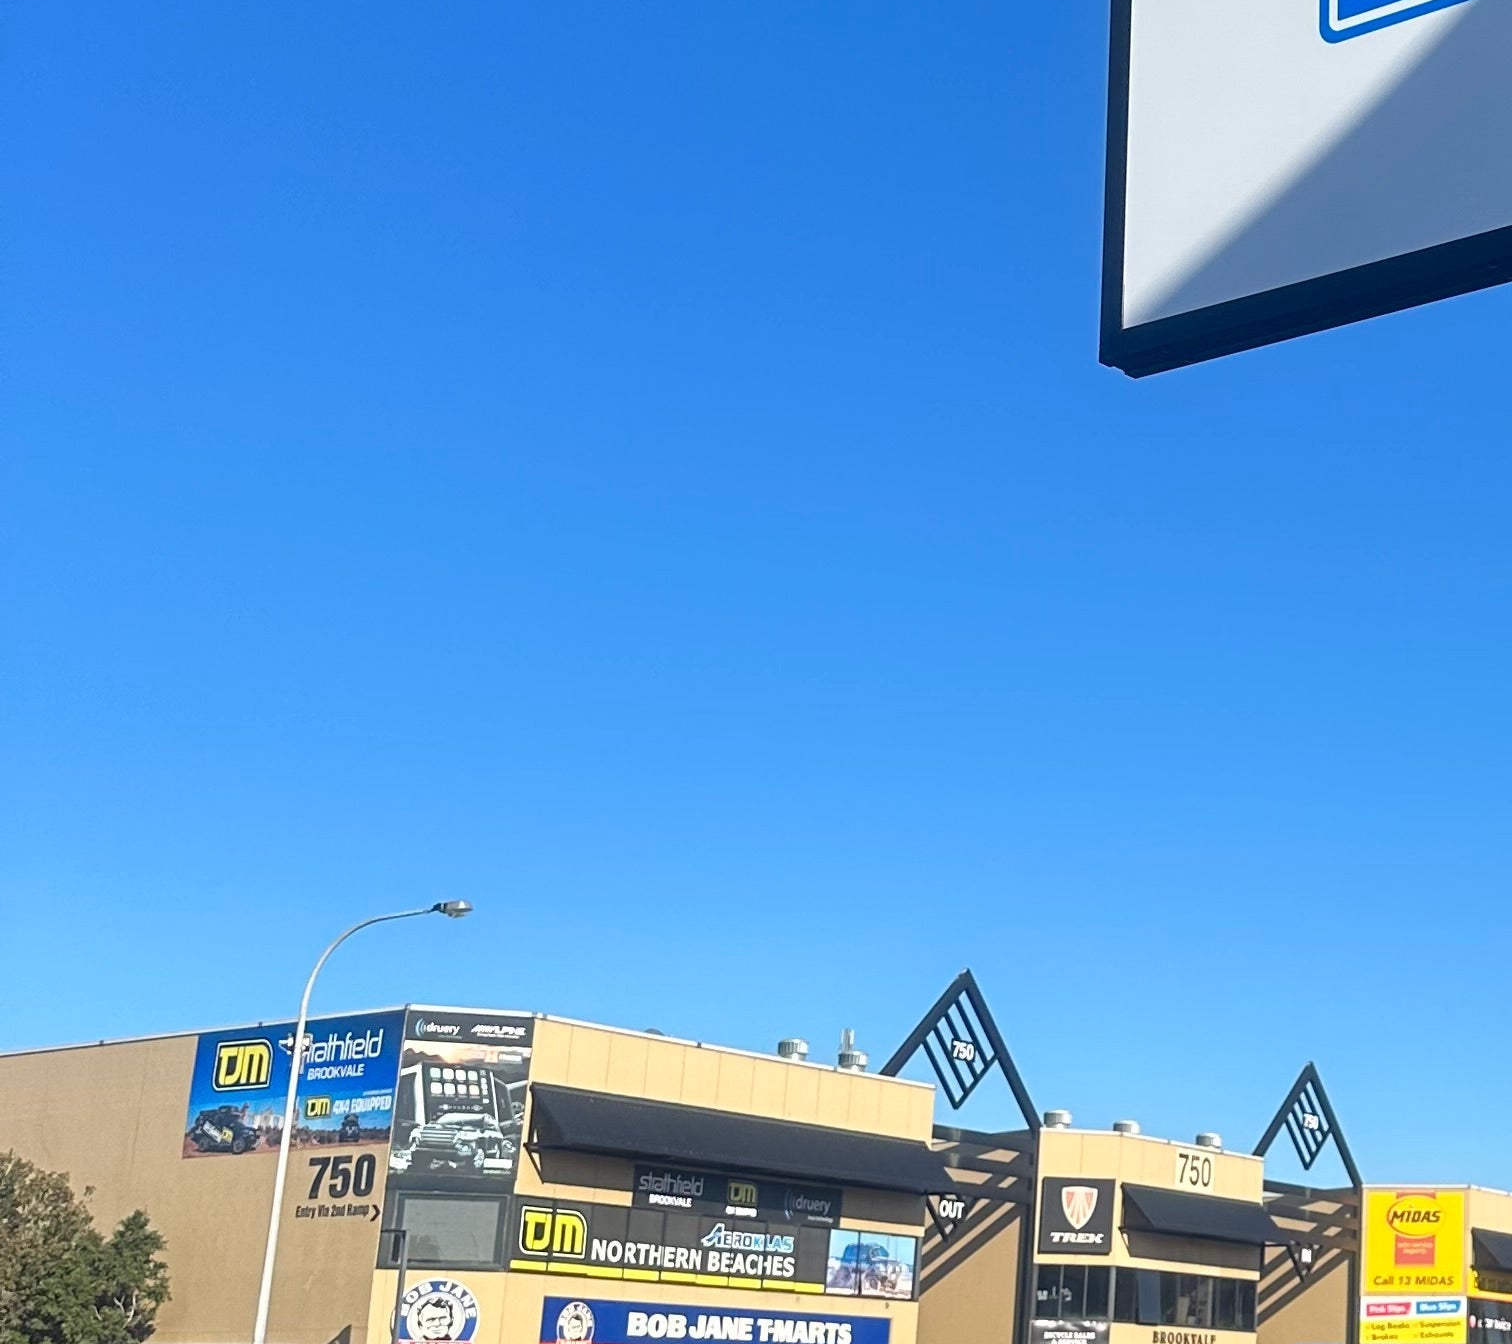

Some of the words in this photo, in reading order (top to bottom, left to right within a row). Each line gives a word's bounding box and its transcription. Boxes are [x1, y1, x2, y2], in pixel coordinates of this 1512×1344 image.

[952, 1040, 975, 1061] 750
[307, 1064, 365, 1081] BROOKVALE
[1303, 1113, 1319, 1130] 750
[308, 1153, 376, 1200] 750
[1178, 1153, 1212, 1188] 750
[638, 1172, 704, 1198] strathfield
[296, 1205, 316, 1219] Entry
[940, 1199, 965, 1219] OUT
[1390, 1210, 1441, 1225] MIDAS
[1050, 1231, 1104, 1244] TREK
[591, 1238, 701, 1270] NORTHERN
[707, 1250, 795, 1278] BEACHES
[1374, 1276, 1394, 1286] Call
[1398, 1276, 1411, 1286] 13
[1415, 1276, 1454, 1286] MIDAS
[439, 1281, 477, 1319] JANE
[627, 1312, 687, 1339] BOB
[689, 1314, 752, 1342] JANE
